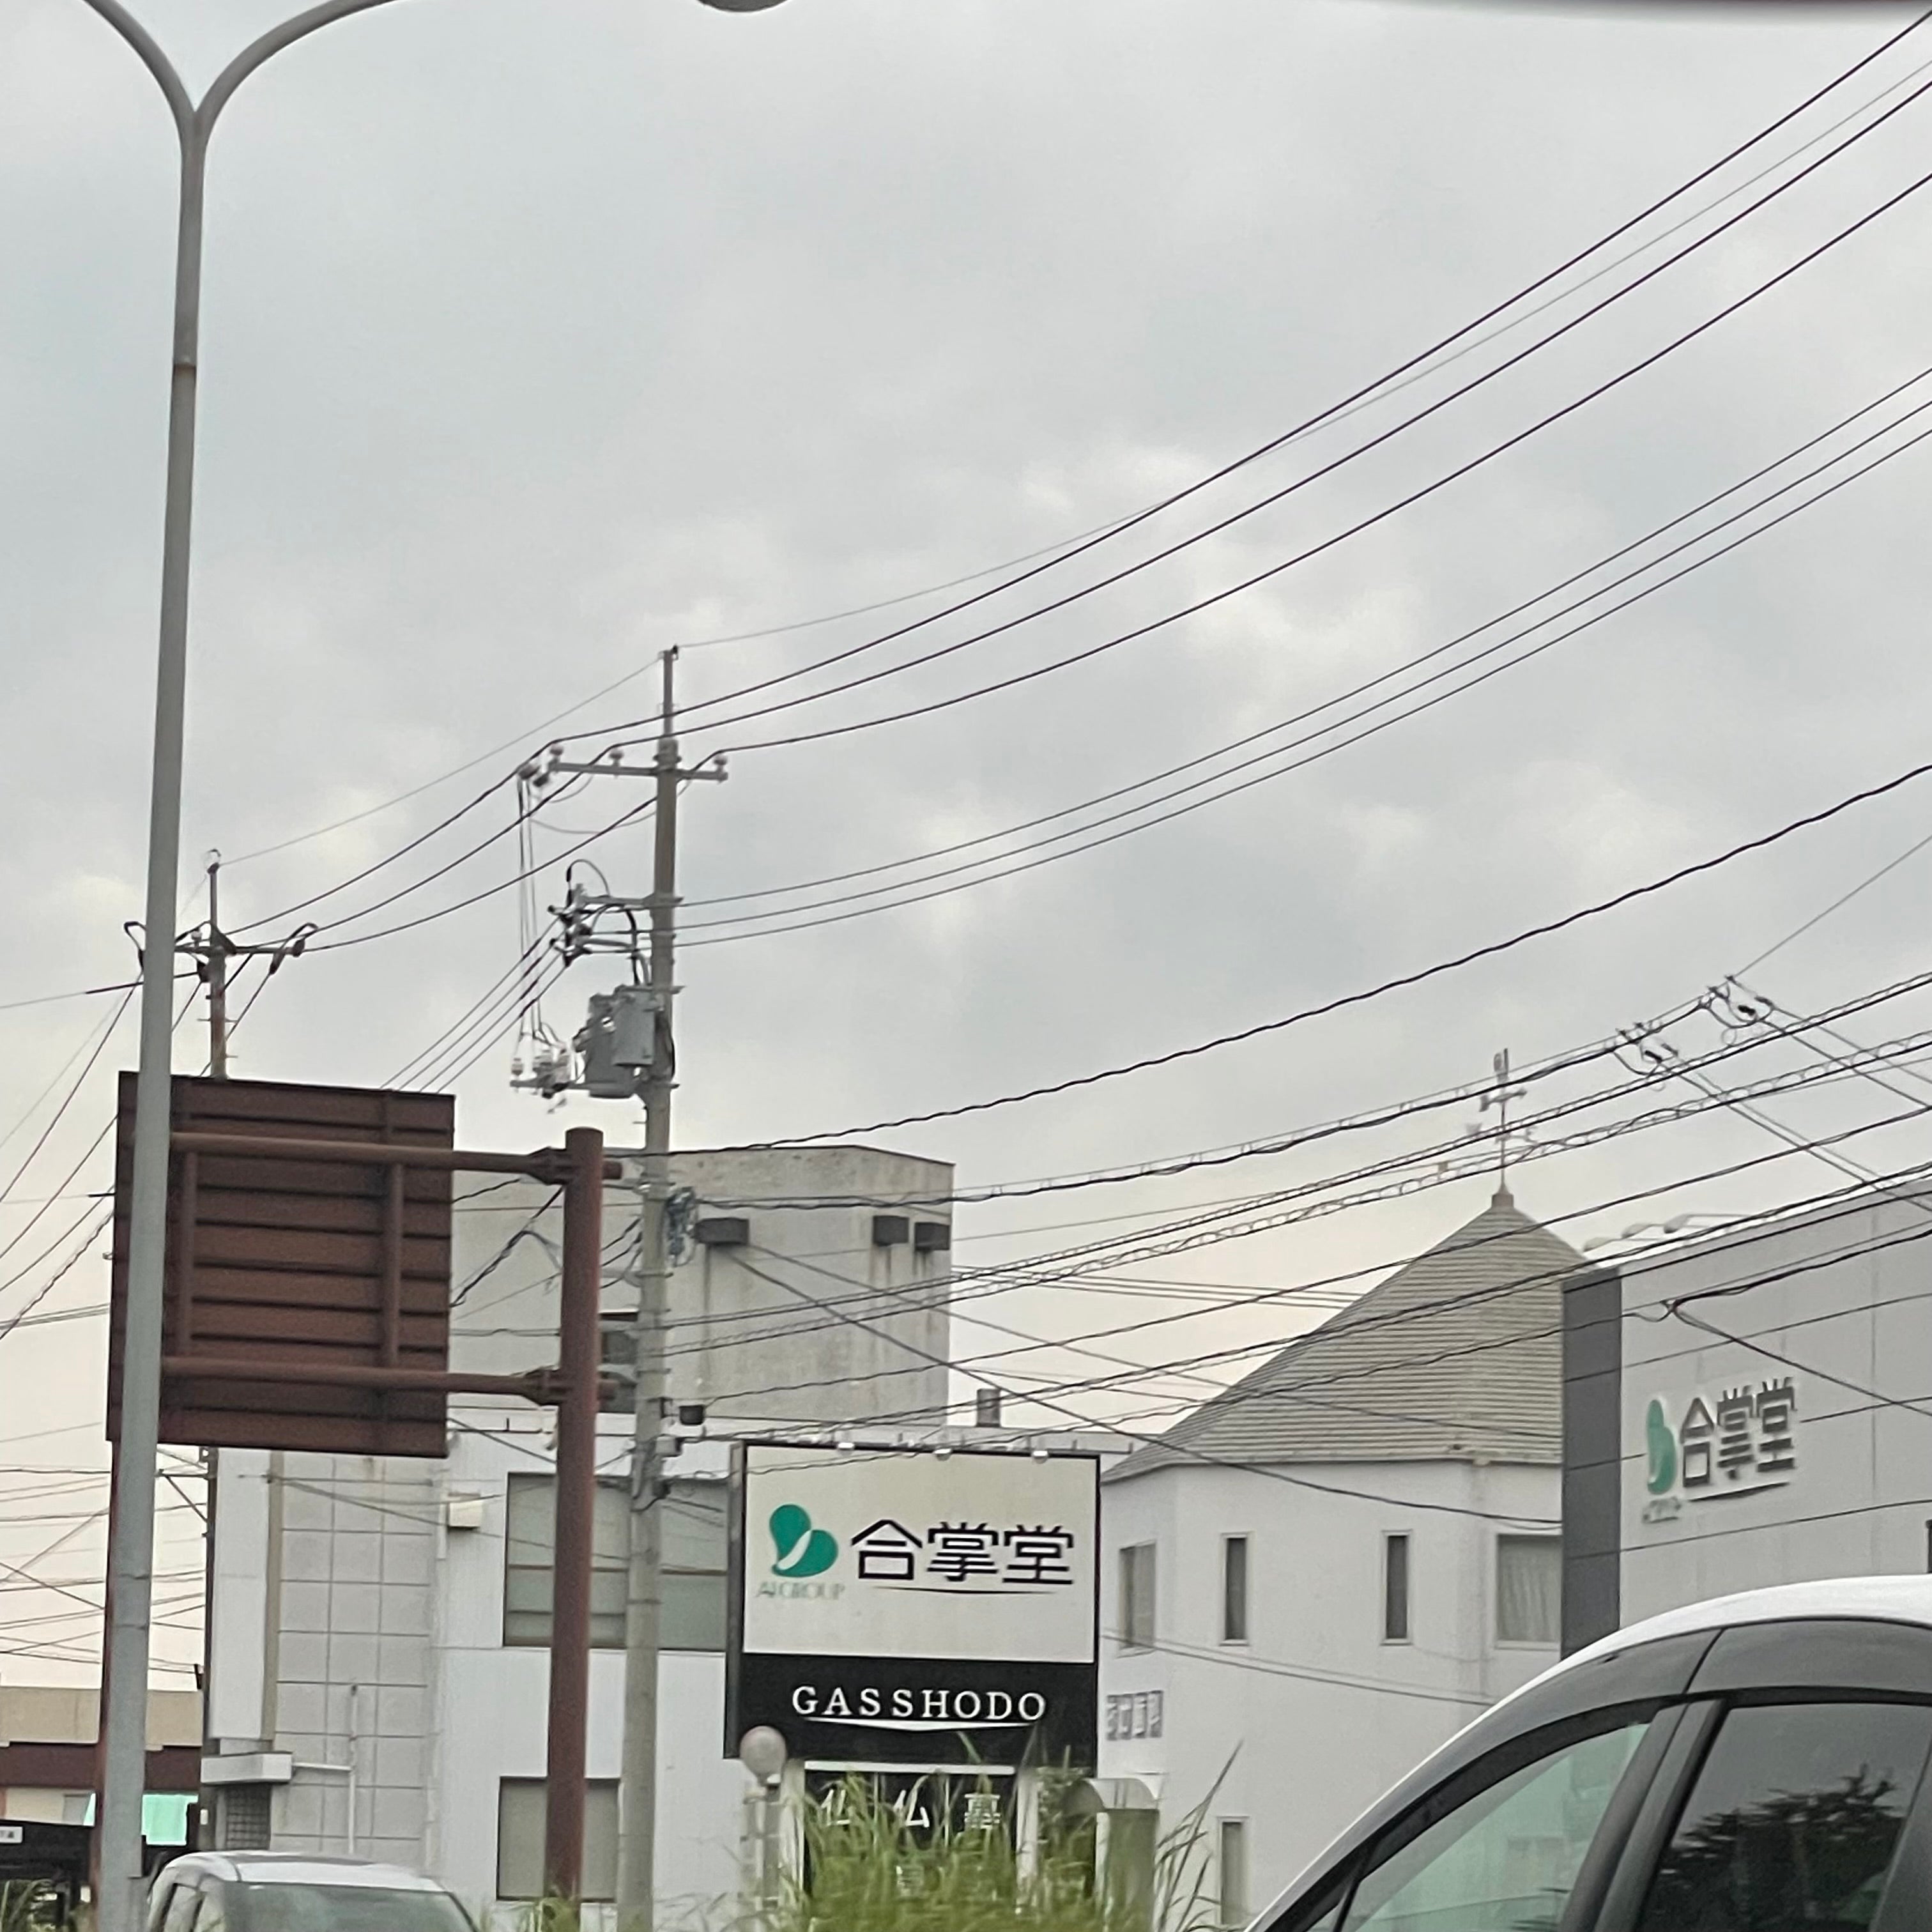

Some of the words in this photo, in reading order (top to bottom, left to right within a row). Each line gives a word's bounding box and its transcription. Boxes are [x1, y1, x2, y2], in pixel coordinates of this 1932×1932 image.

[1680, 1377, 1796, 1487] 合掌堂
[851, 1519, 1073, 1584] 合掌堂
[792, 1686, 1045, 1721] GASSHODO
